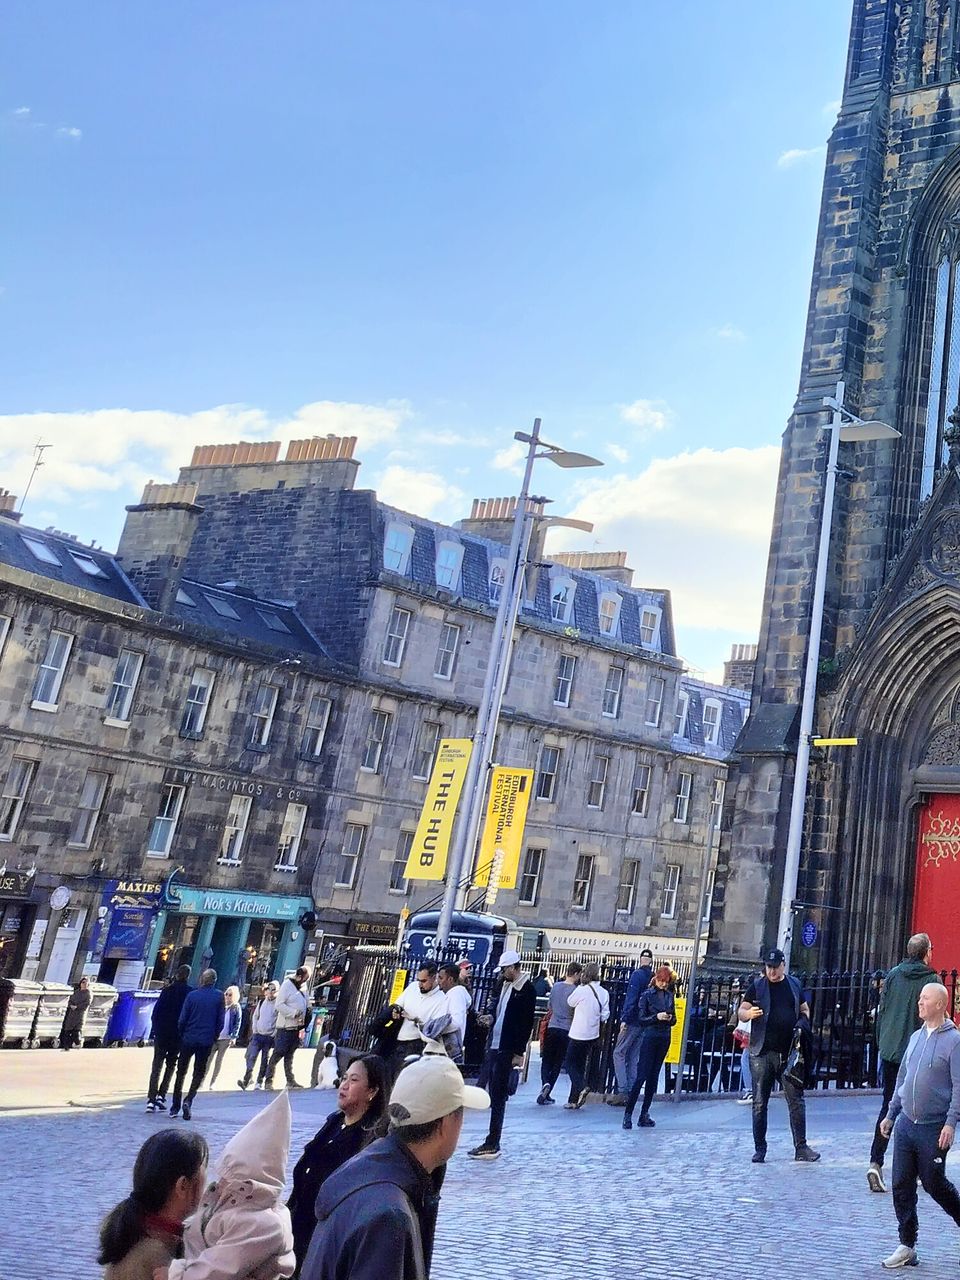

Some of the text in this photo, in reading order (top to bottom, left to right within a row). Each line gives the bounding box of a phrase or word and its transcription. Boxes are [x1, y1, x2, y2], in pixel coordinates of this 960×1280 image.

[492, 773, 505, 814] FESTIVAL
[494, 774, 513, 844] INTERNATIONAL
[504, 775, 520, 828] EDINBURGH
[419, 769, 456, 867] THE HUB
[203, 897, 232, 911] Nok's
[233, 899, 271, 914] Kitchen
[423, 936, 476, 951] CEE
[553, 936, 598, 946] PURVEYORS
[601, 939, 611, 947] OF
[614, 940, 651, 950] CASHMERE
[662, 944, 703, 954] LAMBSWOL
